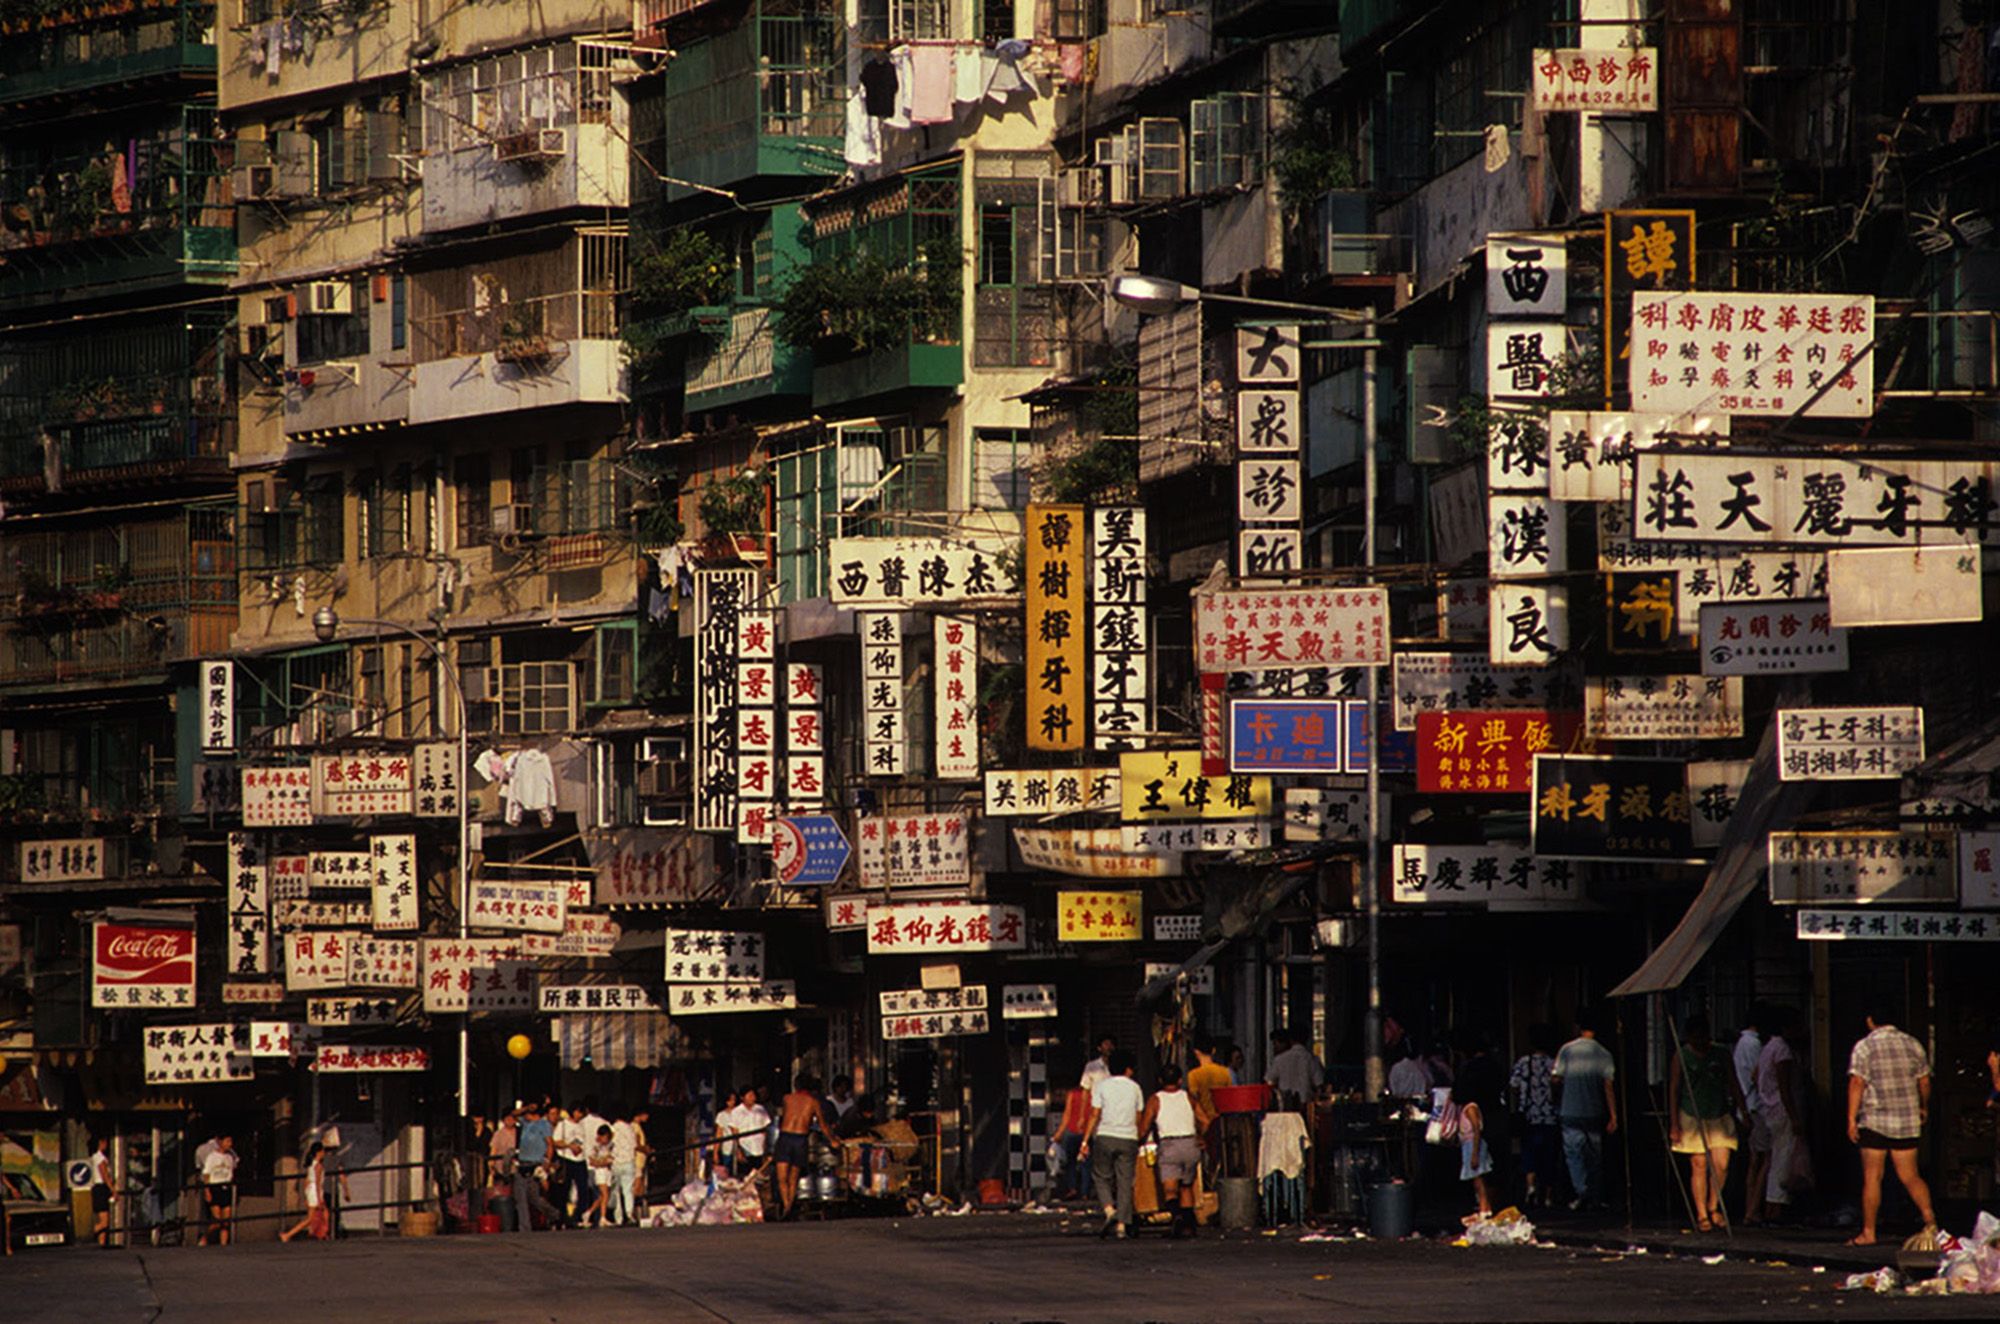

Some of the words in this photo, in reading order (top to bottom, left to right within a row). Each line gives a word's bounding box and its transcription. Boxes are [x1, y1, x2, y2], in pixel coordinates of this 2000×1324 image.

[1540, 56, 1651, 84] 中西診所
[1619, 221, 1677, 285] 譚
[1498, 248, 1554, 654] 西醫陳漢良
[837, 554, 1018, 598] 西醫陳杰
[1039, 513, 1074, 744] 譚樹輝牙科
[1718, 613, 1830, 640] 光明診所
[740, 622, 773, 840] 黃景志牙醫
[790, 668, 822, 816] 黃景志
[870, 617, 899, 773] 孫仰光牙科
[1783, 714, 1892, 742] 富士牙科
